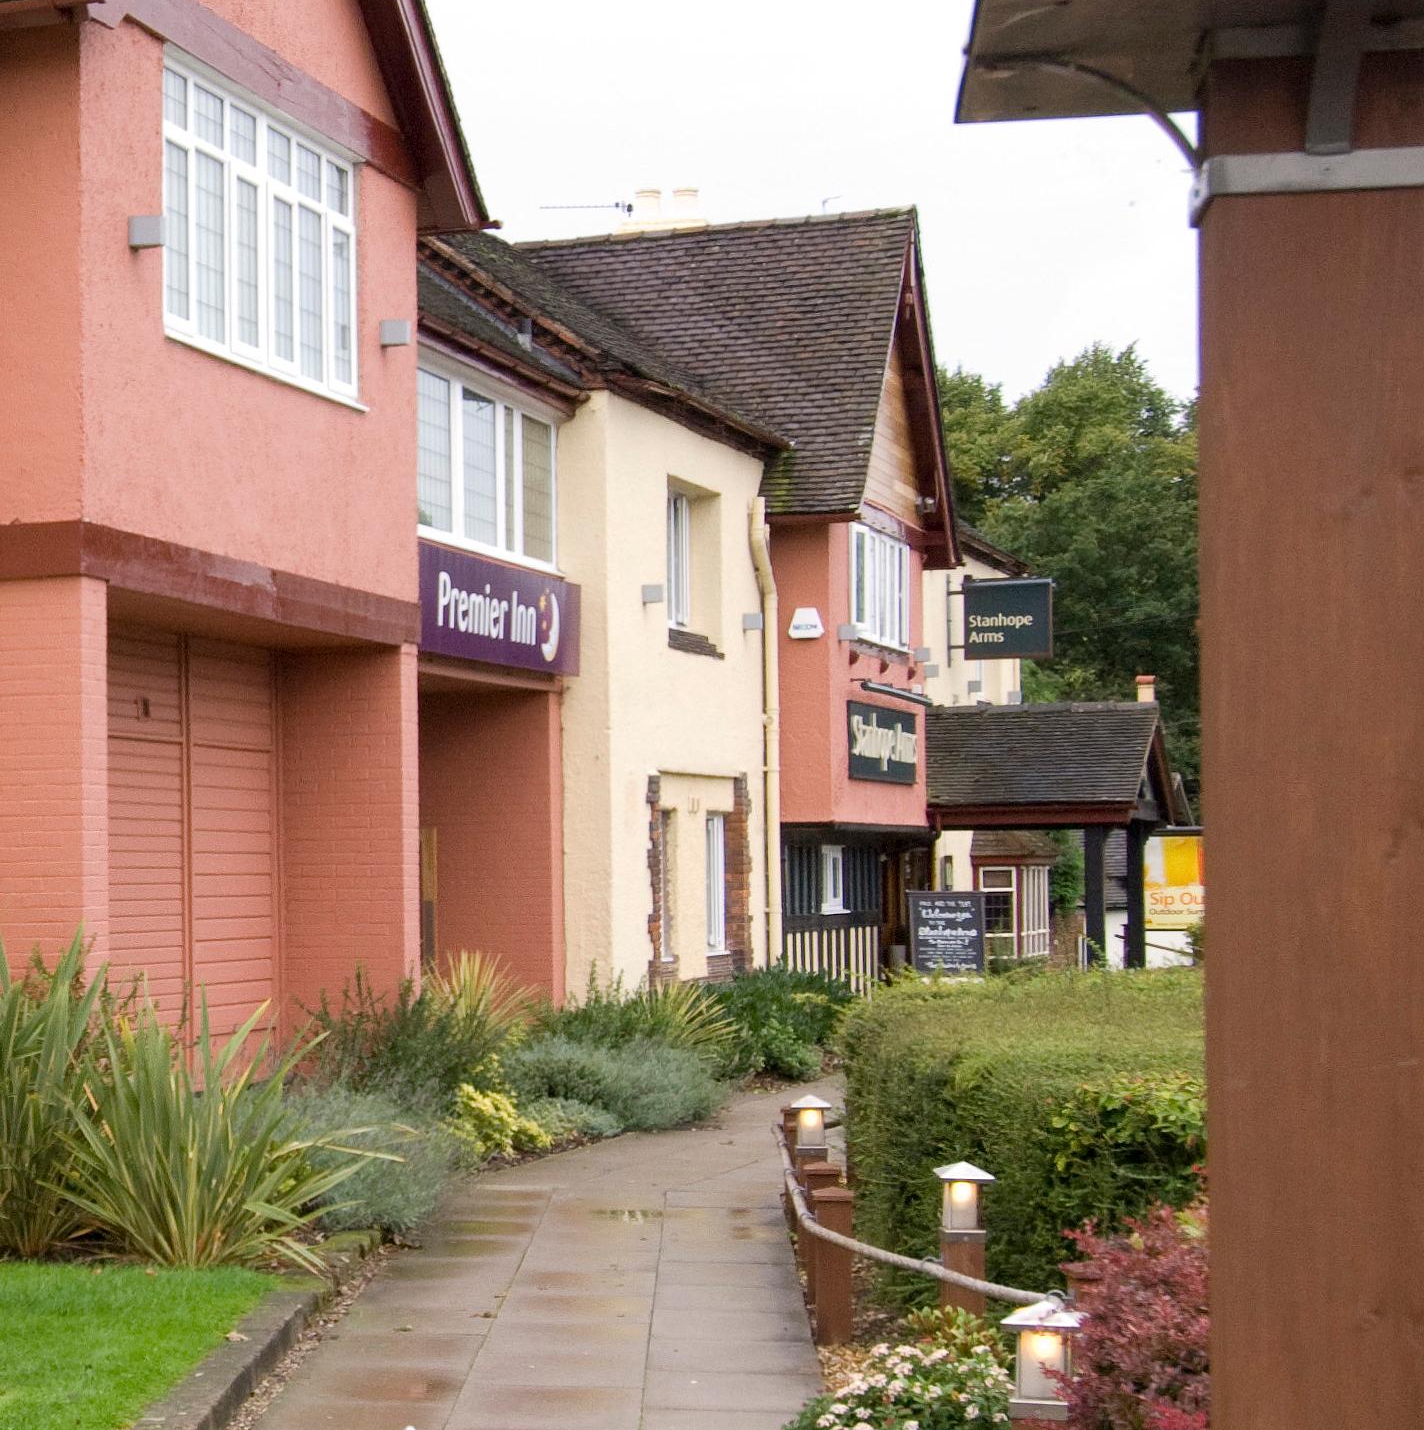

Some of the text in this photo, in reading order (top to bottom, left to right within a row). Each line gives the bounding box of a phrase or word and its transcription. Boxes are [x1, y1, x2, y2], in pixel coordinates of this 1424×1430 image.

[436, 570, 537, 646] Premier Inn
[968, 612, 1033, 629] Stanhope
[968, 631, 1005, 643] Arms
[1150, 892, 1174, 907] Sip
